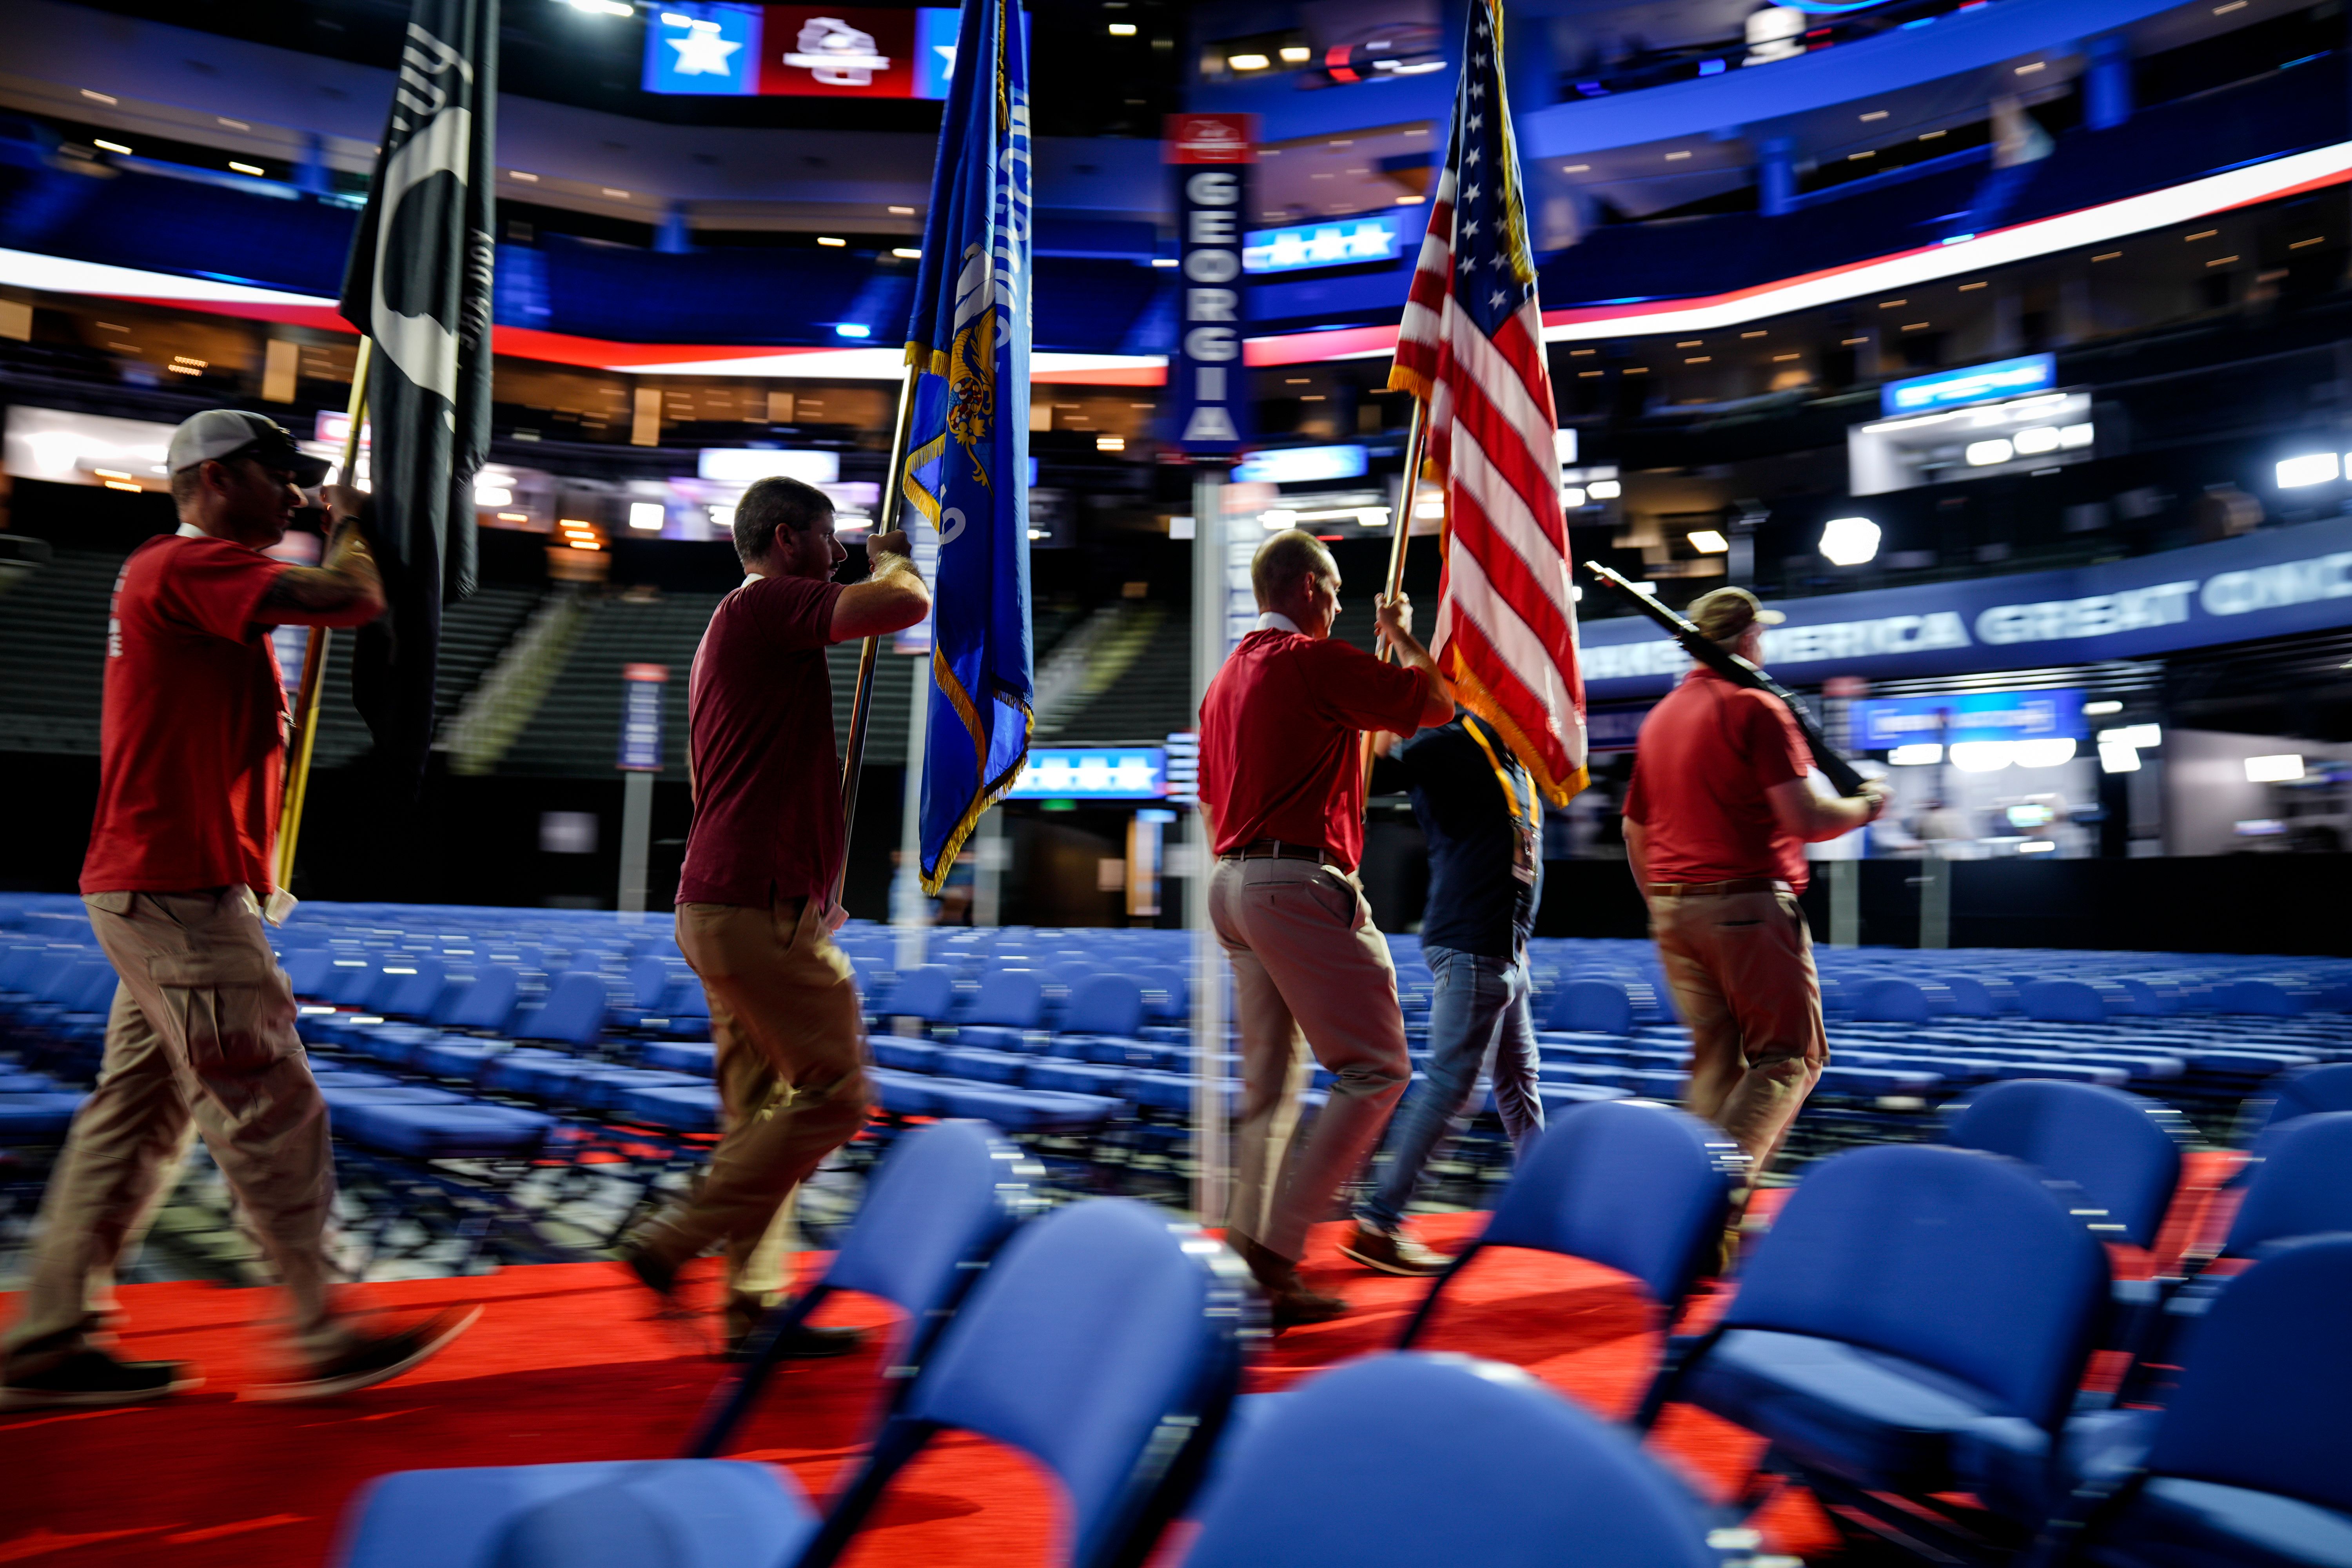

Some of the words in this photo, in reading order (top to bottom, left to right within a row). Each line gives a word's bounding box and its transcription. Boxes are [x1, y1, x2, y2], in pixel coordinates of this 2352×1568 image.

[1181, 172, 1240, 441] GEORGIA
[1756, 611, 1973, 665] MERICA
[1975, 579, 2199, 645] GREAT
